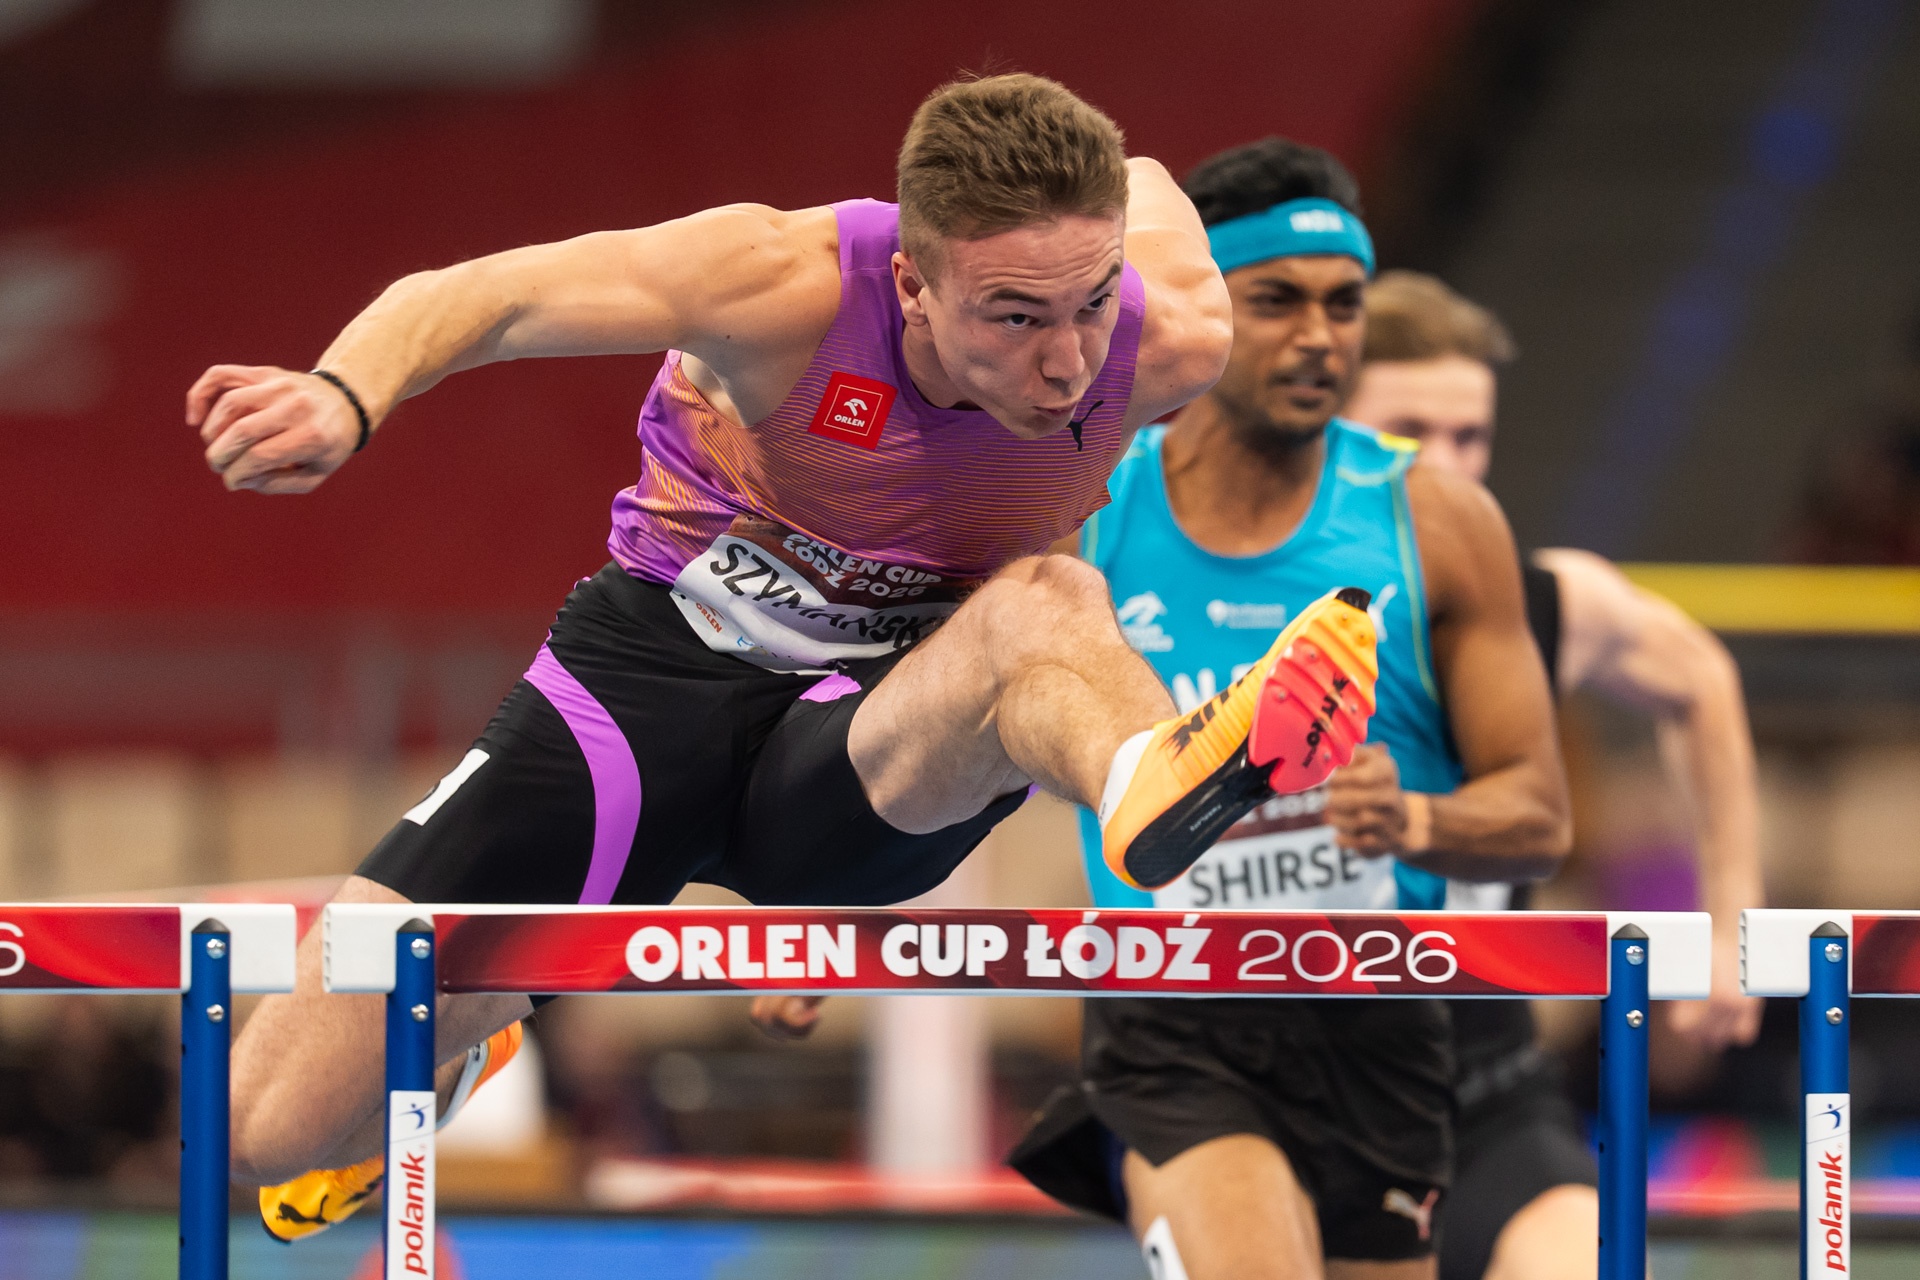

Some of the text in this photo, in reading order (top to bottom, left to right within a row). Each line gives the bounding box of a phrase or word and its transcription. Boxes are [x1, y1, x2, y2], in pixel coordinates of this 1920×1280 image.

[834, 414, 865, 427] ORLEN
[709, 543, 948, 649] SZYMAŃSK
[782, 540, 927, 599] ŁÓDŹ 2026
[885, 565, 942, 584] CUP
[695, 602, 723, 634] ORLEN
[625, 911, 1459, 983] ORLEN CUP ŁÓDŹ 2026
[398, 1151, 429, 1276] polanik
[1817, 1151, 1847, 1272] polanik
